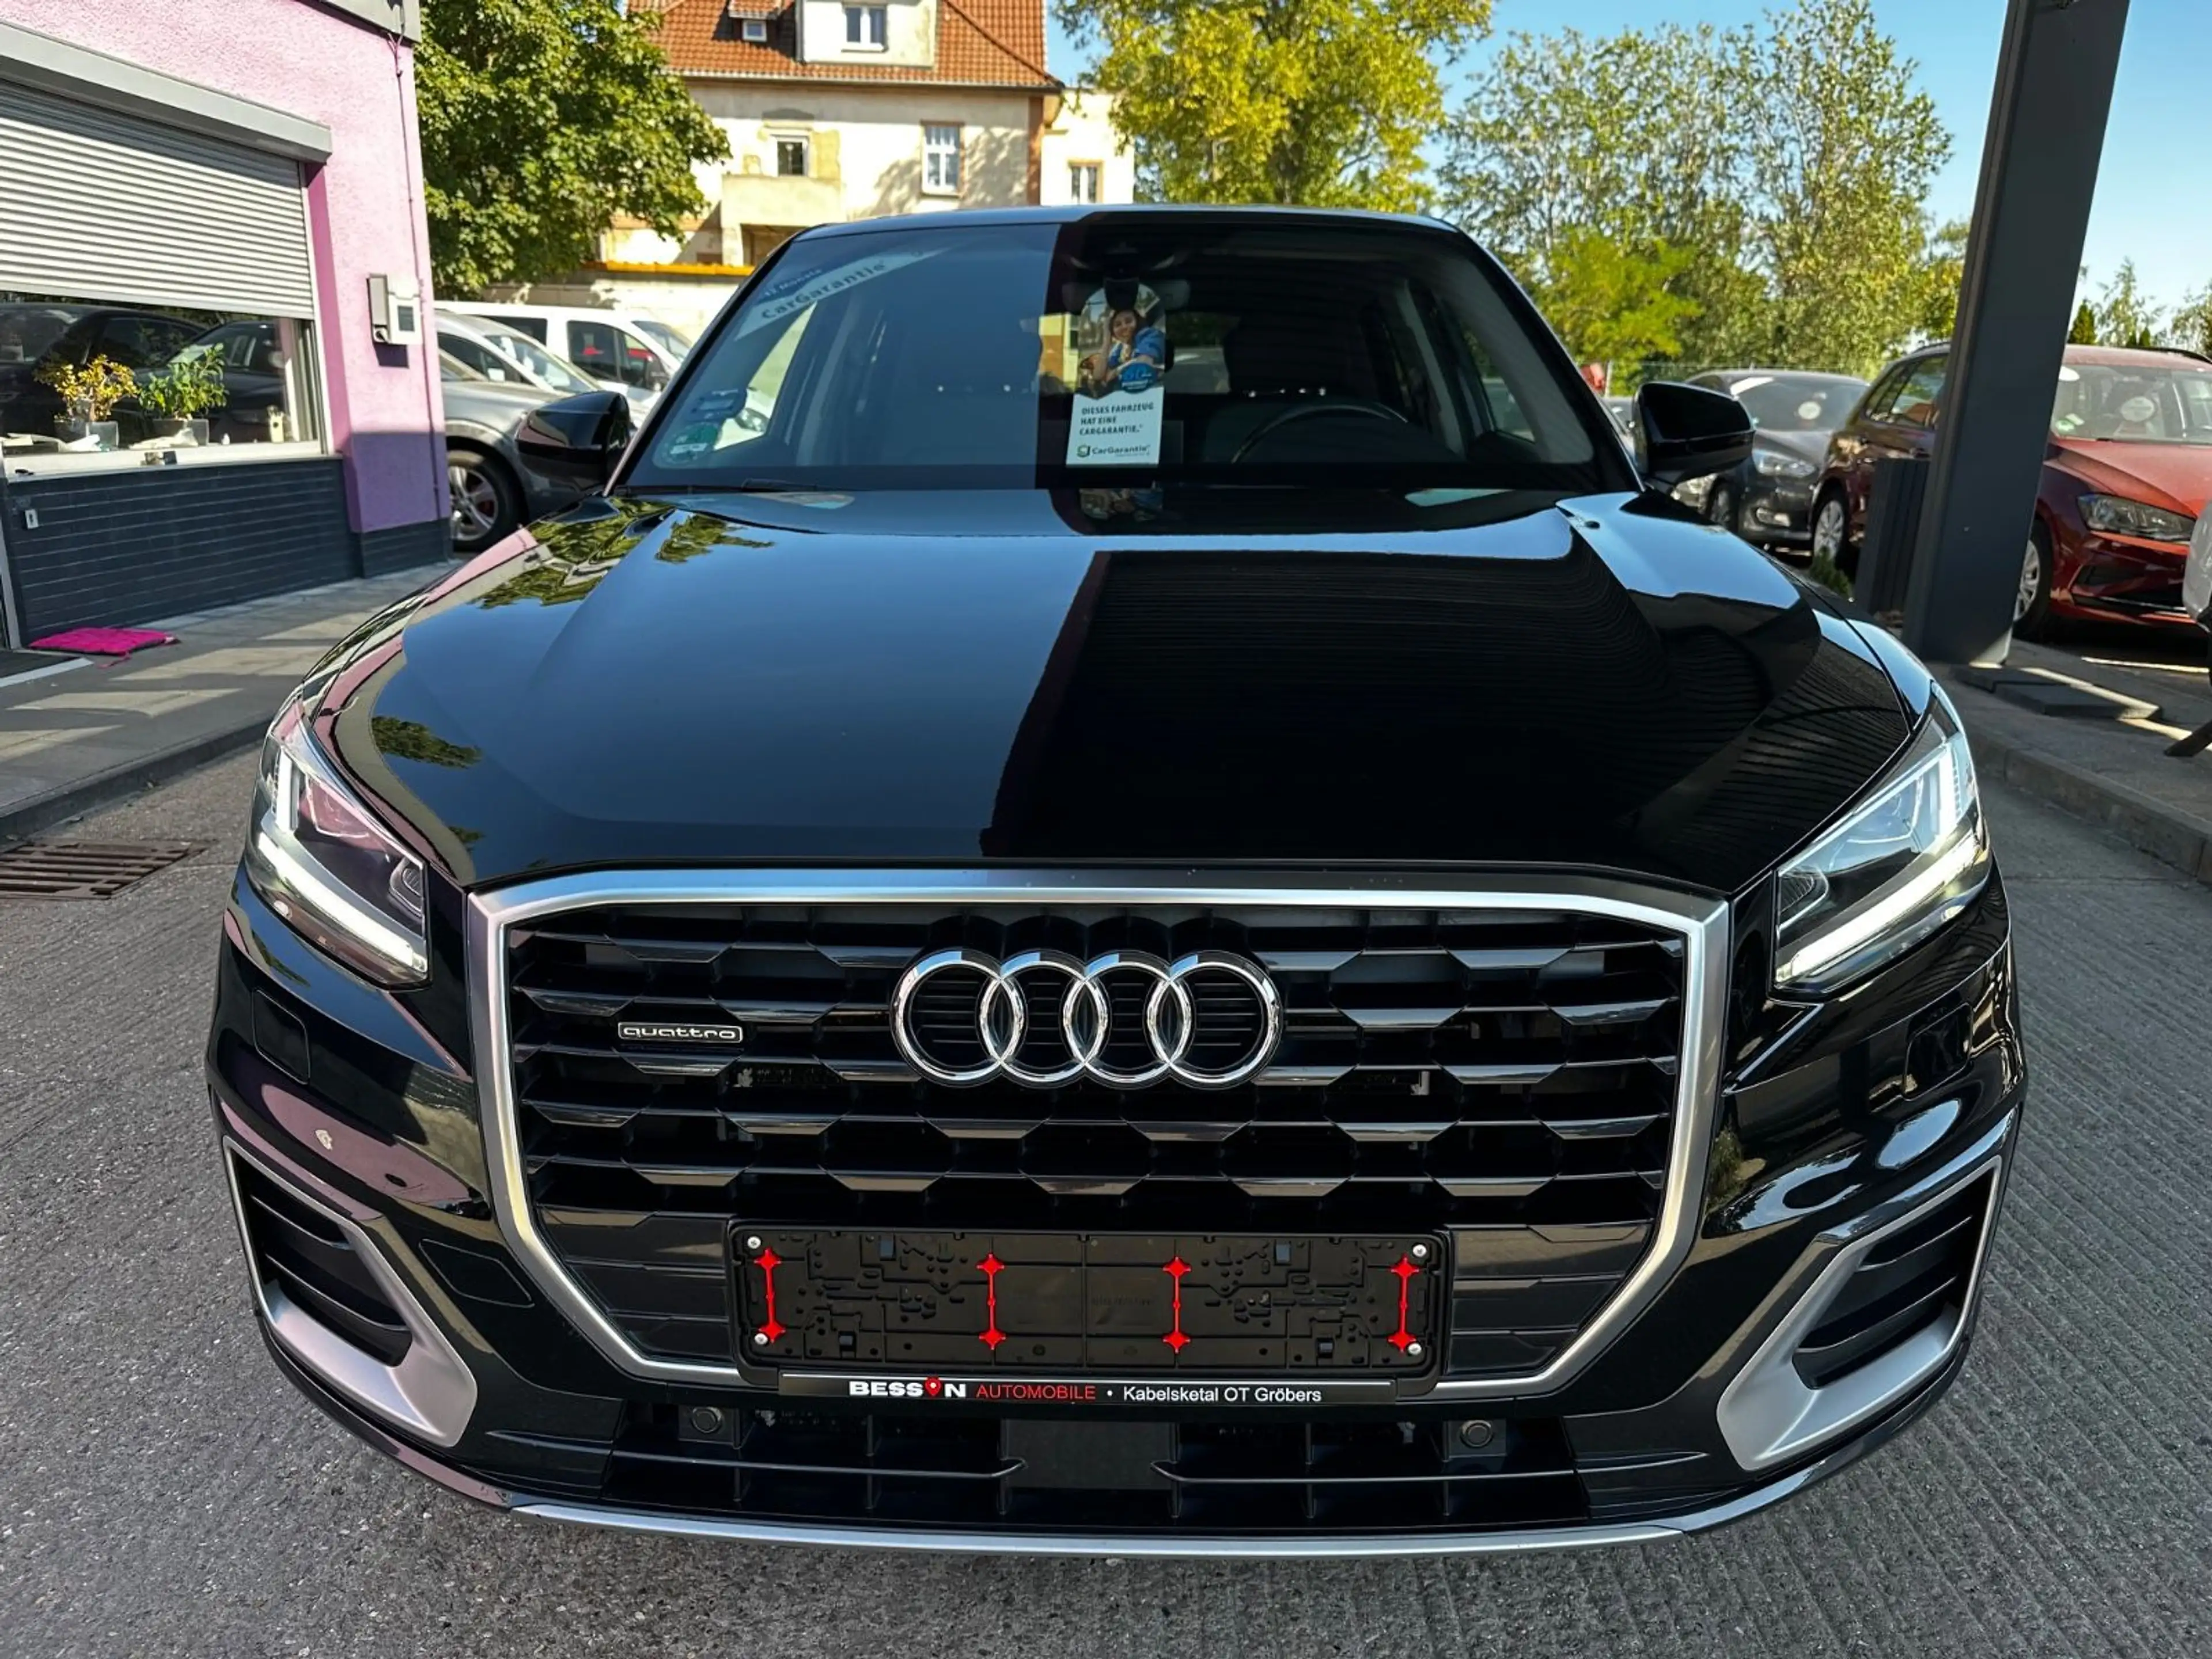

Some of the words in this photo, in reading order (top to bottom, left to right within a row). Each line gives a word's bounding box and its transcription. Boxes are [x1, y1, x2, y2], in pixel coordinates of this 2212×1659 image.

[1081, 406, 1109, 415] DIESES
[1112, 403, 1154, 413] FAHRZEUG
[1081, 416, 1097, 425] HAT
[1098, 415, 1116, 425] EINE
[623, 1027, 736, 1039] quattro
[976, 1385, 1096, 1400] AUTOMOBILE
[1123, 1385, 1219, 1402] Kabelsketal
[1224, 1387, 1250, 1402] OT
[1254, 1387, 1322, 1402] Gröbers
